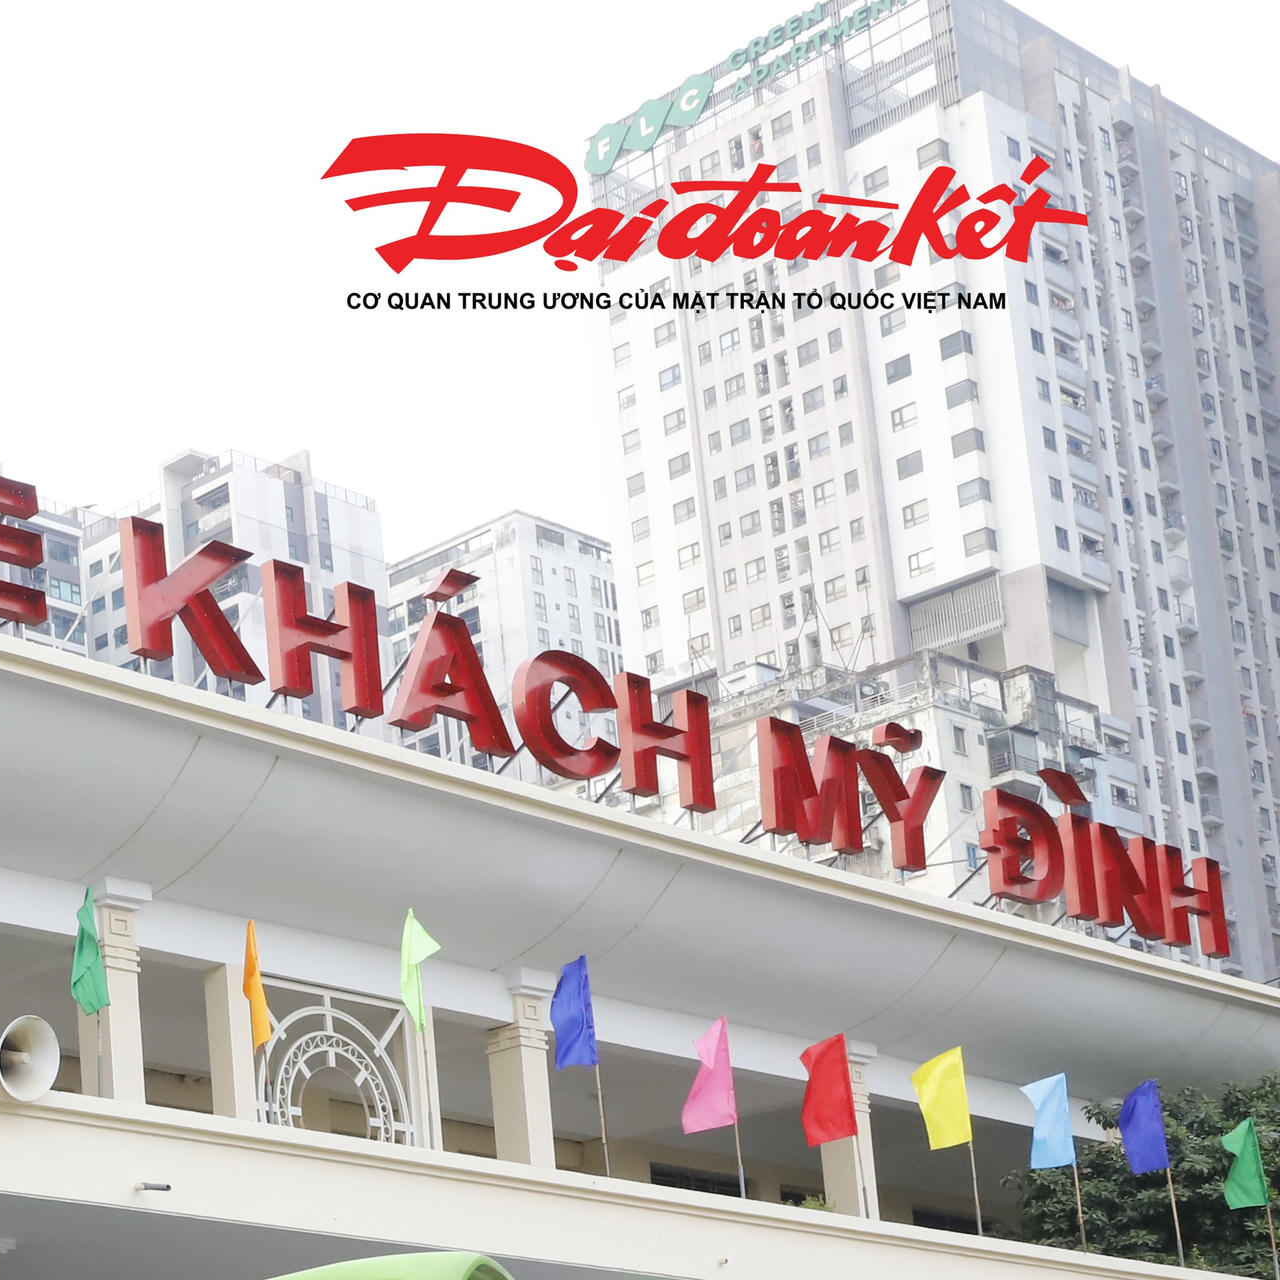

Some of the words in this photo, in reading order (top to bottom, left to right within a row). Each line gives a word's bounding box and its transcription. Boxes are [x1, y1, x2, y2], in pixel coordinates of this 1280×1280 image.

[726, 2, 825, 72] GREEN
[596, 87, 700, 162] FLC
[117, 515, 715, 815] KHÁCH
[756, 715, 946, 873] MỸ
[978, 768, 1232, 960] ĐÌNH
